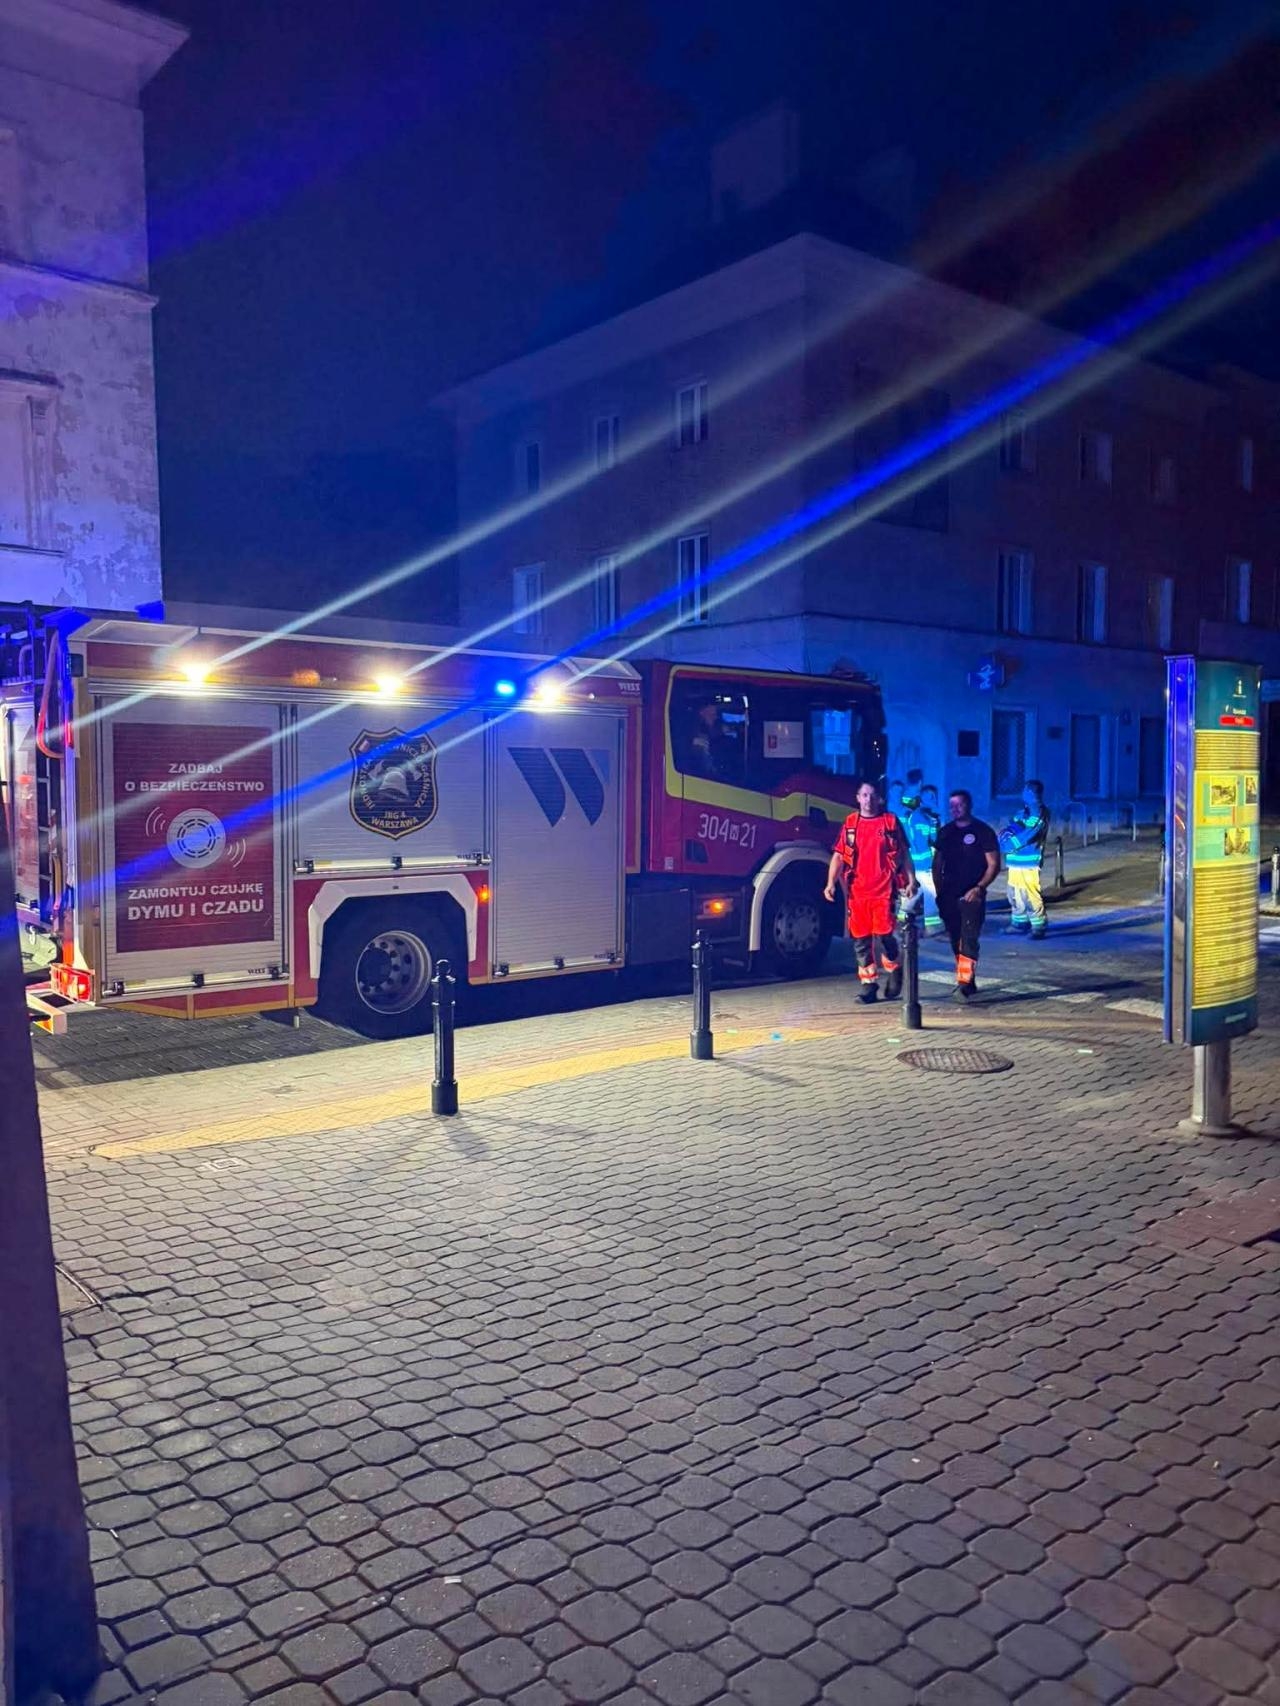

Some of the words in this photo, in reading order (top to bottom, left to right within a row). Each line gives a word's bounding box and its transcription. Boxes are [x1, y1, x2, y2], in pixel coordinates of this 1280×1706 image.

[168, 763, 223, 774] ZADBAJ
[124, 781, 136, 792] O
[140, 779, 265, 792] BEZPIECZEŃSTWO
[371, 816, 419, 829] WARSZAWA
[128, 886, 206, 900] ZAMONTUJ
[210, 883, 264, 896] CZUJKĘ
[128, 904, 184, 921] DYMU
[190, 902, 197, 917] I
[202, 899, 264, 915] CZADU
